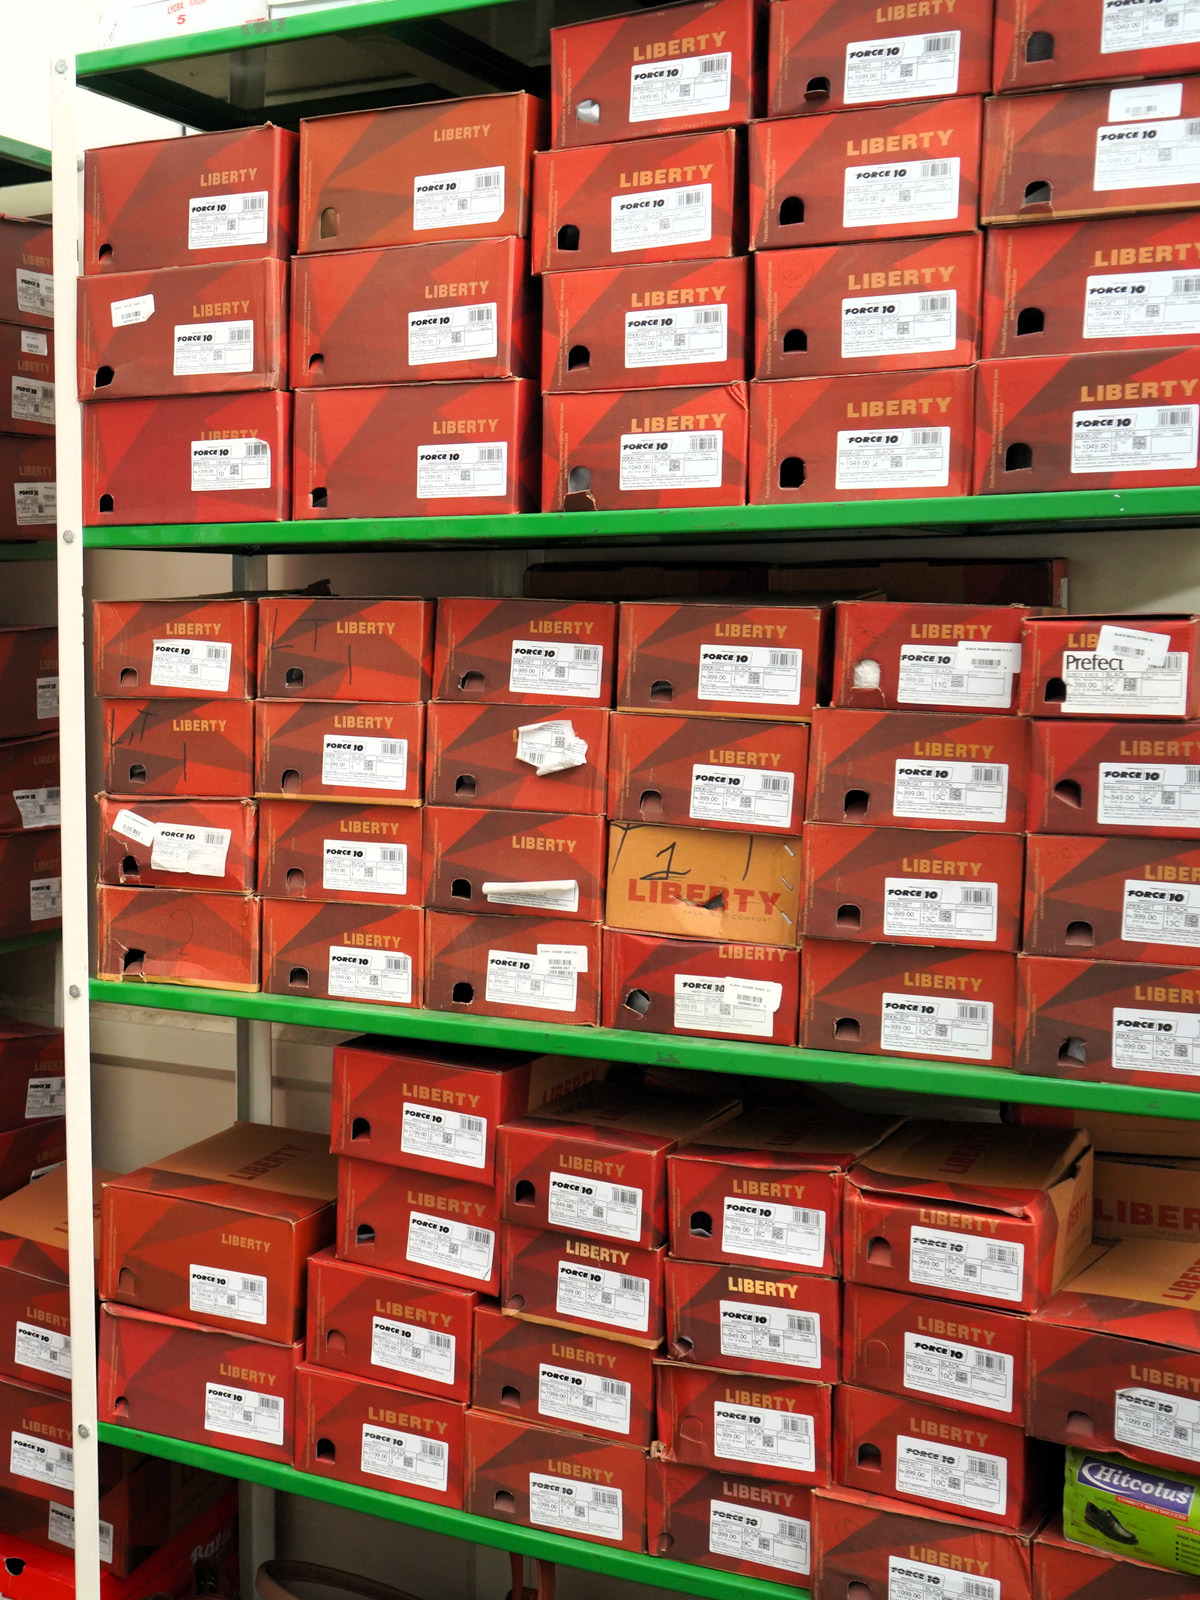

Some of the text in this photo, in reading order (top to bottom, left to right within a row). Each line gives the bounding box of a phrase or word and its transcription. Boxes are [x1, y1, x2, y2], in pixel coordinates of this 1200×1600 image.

[177, 14, 186, 24] 5
[876, 1, 955, 23] LIBERTY
[633, 31, 727, 62] LIBERTY
[633, 68, 679, 80] FORCE 10
[433, 125, 491, 143] LIBERTY
[846, 129, 955, 157] LIBERTY
[200, 168, 258, 188] LIBERTY
[620, 164, 713, 188] LIBERTY
[417, 182, 457, 193] FORCE 10
[191, 203, 226, 214] FORCE 10
[847, 266, 956, 291] LIBERTY
[424, 281, 489, 299] LIBERTY
[631, 286, 726, 308] LIBERTY
[1089, 284, 1146, 295] FORCE 10
[192, 300, 250, 318] LIBERTY
[1081, 379, 1199, 402] LIBERTY
[847, 397, 953, 419] LIBERTY
[433, 419, 498, 435] LIBERTY
[631, 413, 727, 433] LIBERTY
[1075, 418, 1131, 427] FORCE 10
[622, 442, 668, 451] FORCE 10
[166, 623, 221, 635] LIBERTY
[336, 621, 395, 635] LIBERTY
[529, 619, 594, 635] LIBERTY
[715, 623, 788, 639] LIBERTY
[911, 623, 992, 640] LIBERTY
[703, 653, 748, 663] FORCE 10
[334, 716, 394, 729] LIBERTY
[709, 749, 782, 766] LIBERTY
[914, 741, 994, 759] LIBERTY
[340, 820, 399, 835] LIBERTY
[902, 858, 982, 876] LIBERTY
[887, 888, 938, 899] FORCE 10
[343, 933, 402, 949] LIBERTY
[718, 945, 787, 962] LIBERTY
[904, 972, 982, 992] LIBERTY
[402, 1083, 481, 1109] LIBERTY
[559, 1154, 625, 1178] LIBERTY
[733, 1179, 805, 1199] LIBERTY
[407, 1191, 487, 1218] LIBERTY
[919, 1208, 1000, 1233] LIBERTY
[222, 1232, 271, 1253] LIBERTY
[566, 1240, 630, 1266] LIBERTY
[728, 1277, 799, 1299] LIBERTY
[913, 1342, 963, 1359] FORCE 10
[1131, 1365, 1200, 1392] LIBERT
[725, 1389, 796, 1410] LIBERTY
[368, 1406, 449, 1436] LIBERTY
[910, 1417, 989, 1447] LIBERTY
[1094, 1465, 1190, 1505] Hitcolus
[723, 1482, 794, 1507] LIBERTY
[1145, 1503, 1159, 1512] WITH
[910, 1545, 989, 1575] LIBERTY
